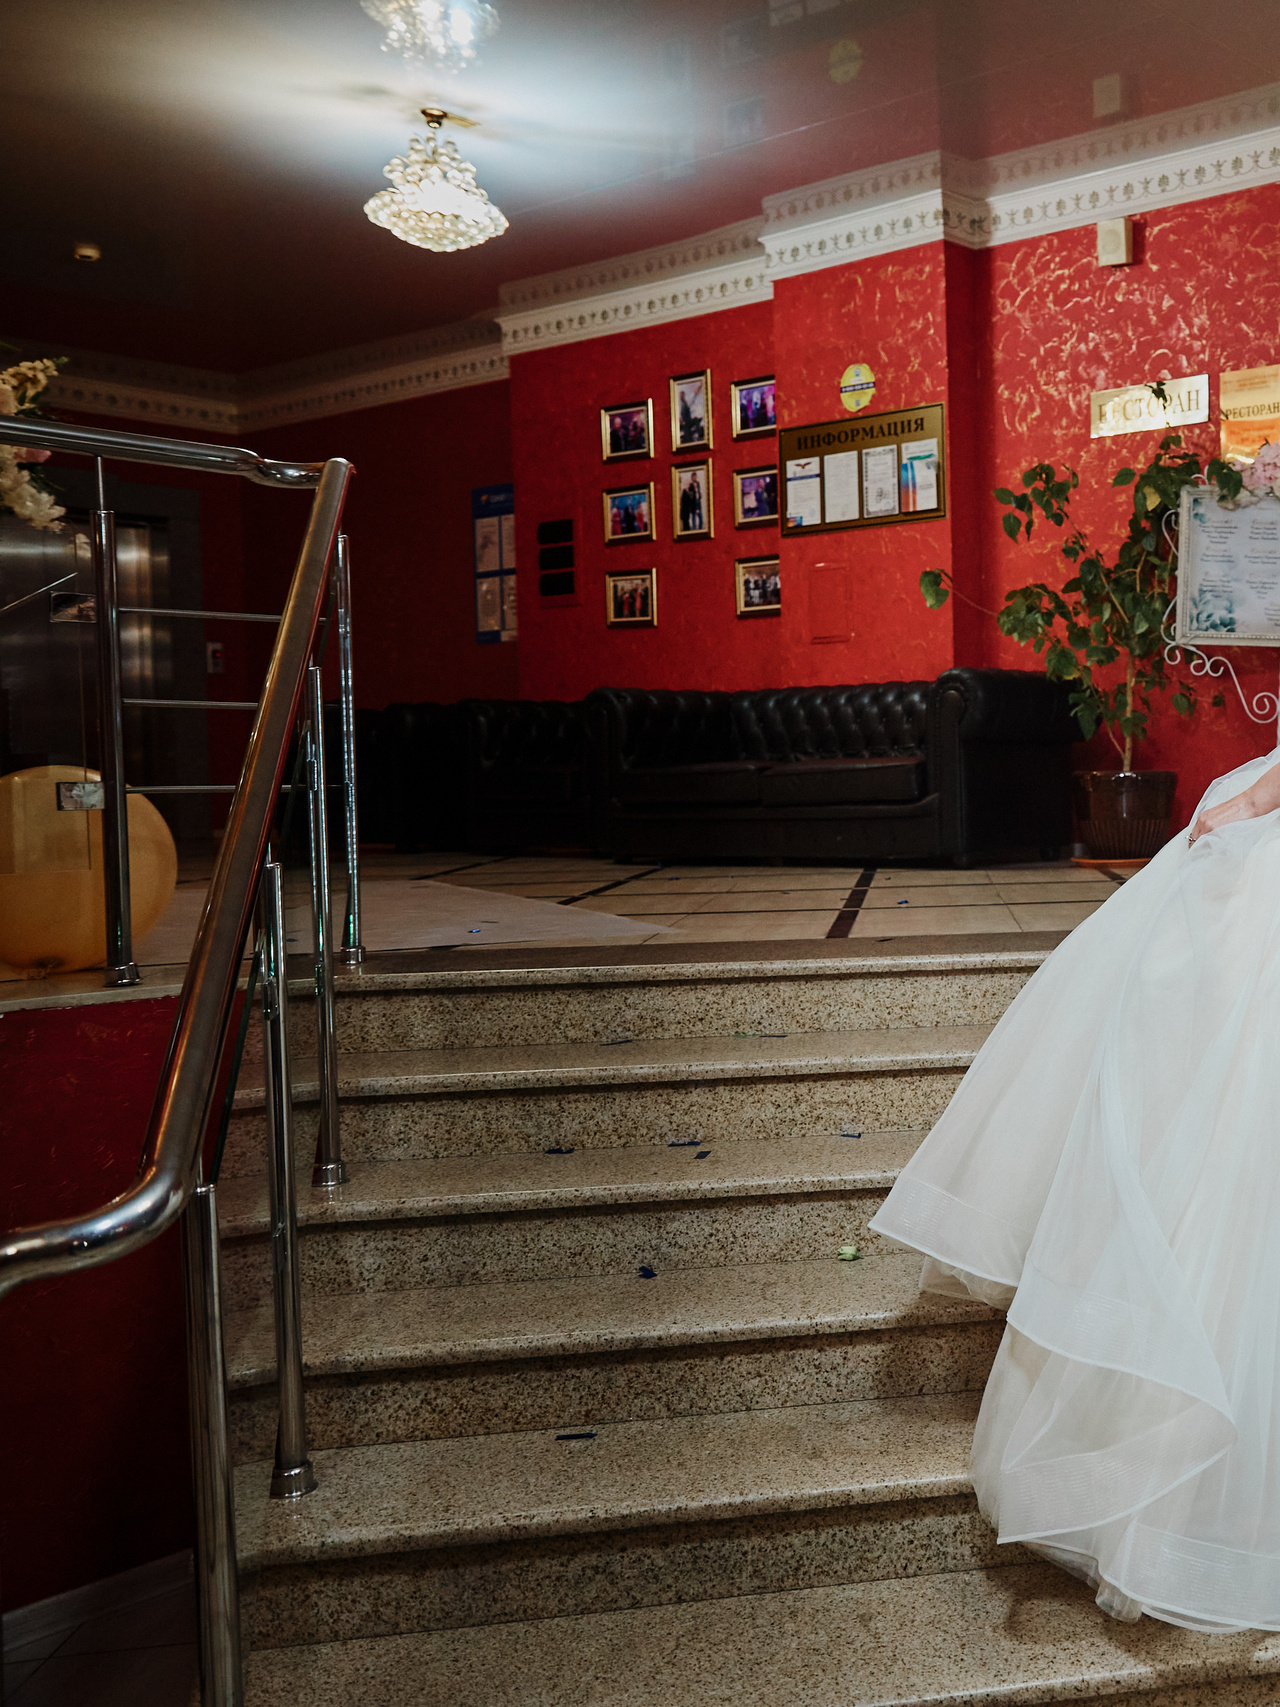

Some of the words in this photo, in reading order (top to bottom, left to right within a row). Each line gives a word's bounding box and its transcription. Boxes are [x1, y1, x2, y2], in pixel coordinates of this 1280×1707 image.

[1098, 389, 1199, 423] РЕСТОРАН
[1225, 402, 1280, 419] РЕСТОРАН
[797, 417, 925, 450] ИНФОРМАЦИЯ
